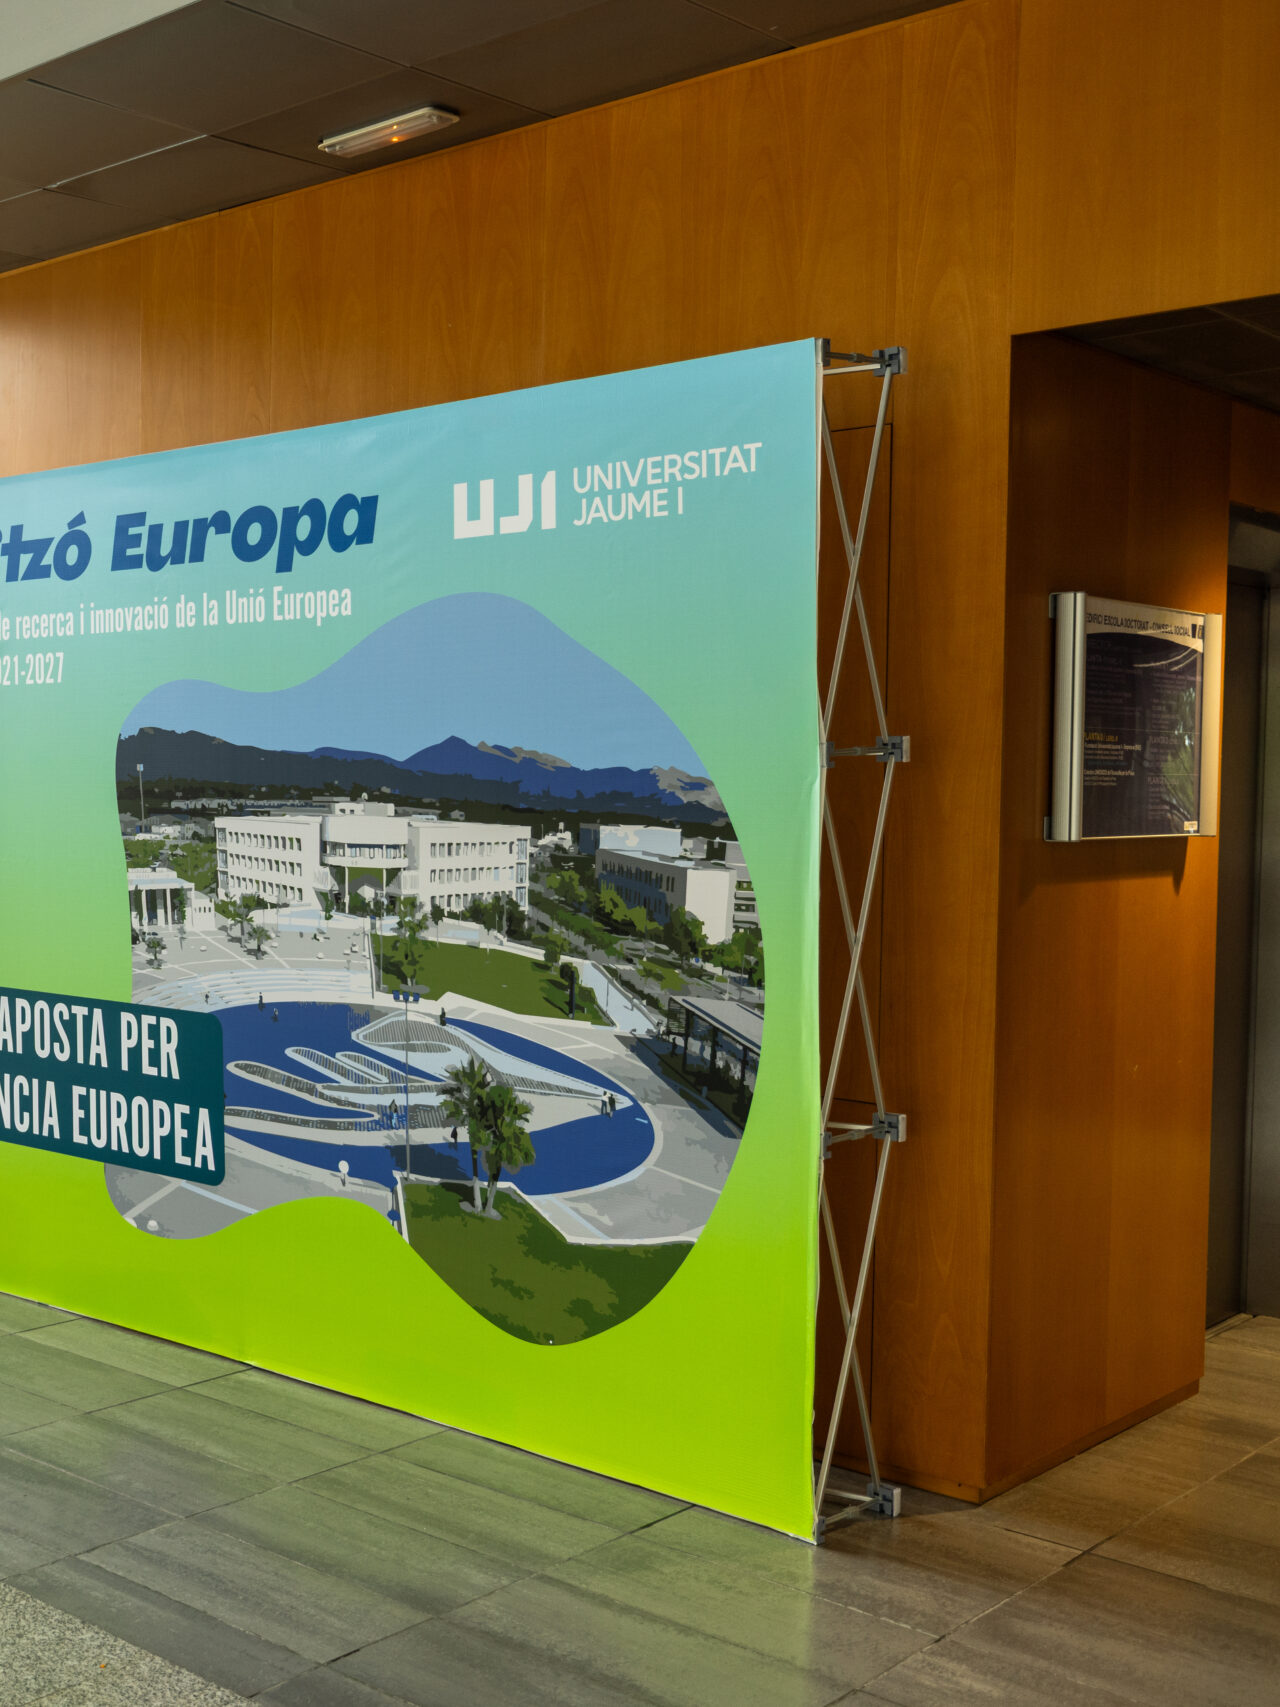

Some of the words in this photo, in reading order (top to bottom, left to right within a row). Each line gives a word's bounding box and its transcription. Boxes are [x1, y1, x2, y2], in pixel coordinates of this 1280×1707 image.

[453, 470, 556, 539] UJI
[572, 442, 763, 494] UNIVERSITAT
[572, 487, 669, 527] JAUME
[677, 486, 684, 515] I
[110, 493, 380, 574] Europa
[15, 610, 74, 640] recerca
[79, 604, 85, 634] i
[90, 600, 169, 634] innovació
[176, 595, 196, 628] de
[203, 592, 218, 626] la
[225, 587, 266, 624] Unió
[273, 586, 353, 627] Europea
[120, 1011, 180, 1080] PER
[72, 1085, 216, 1171] EUROPEA
